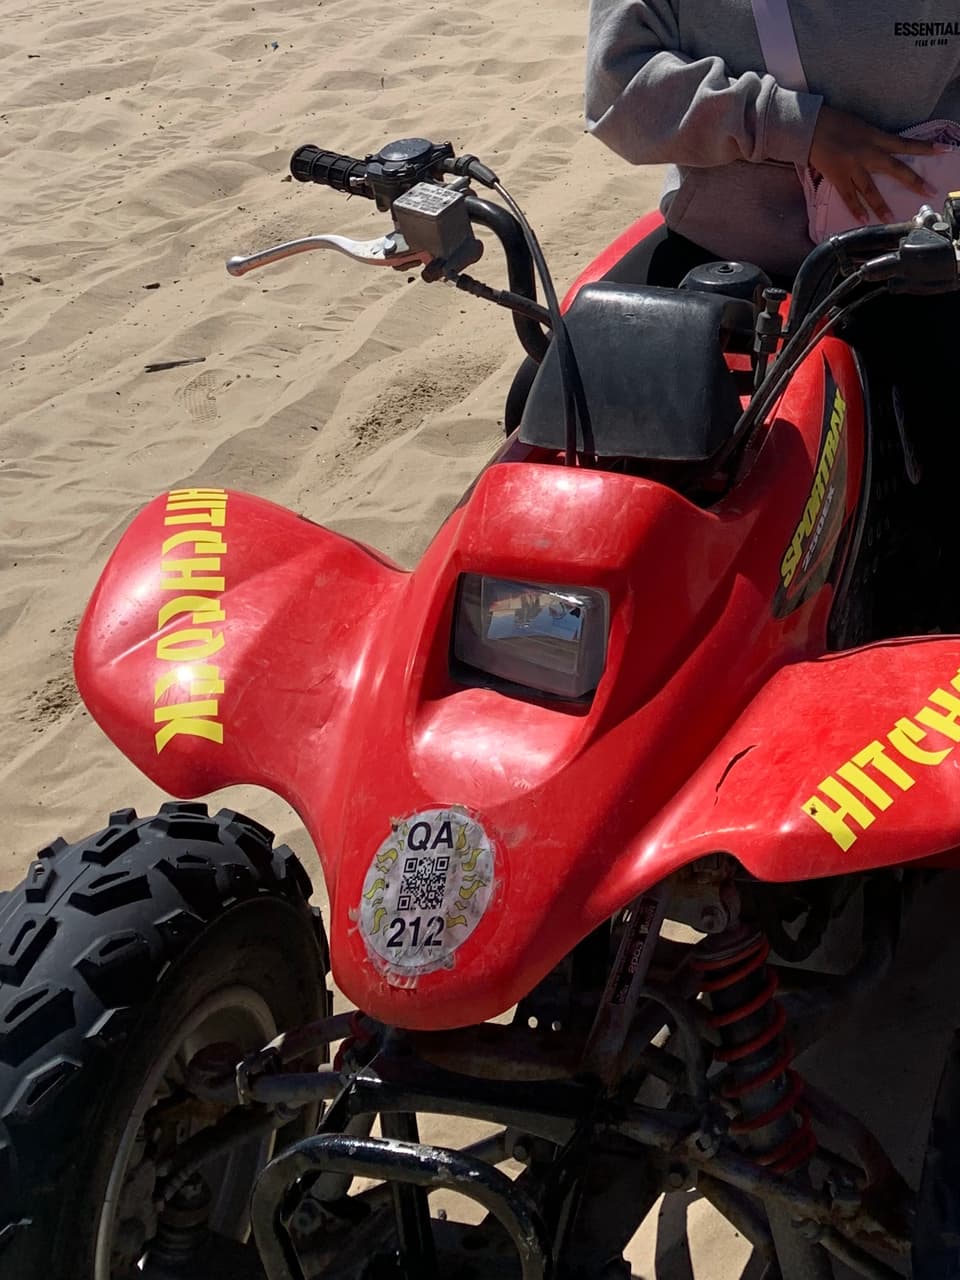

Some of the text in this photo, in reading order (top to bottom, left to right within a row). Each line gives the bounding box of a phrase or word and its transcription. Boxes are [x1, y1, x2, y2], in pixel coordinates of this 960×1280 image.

[781, 387, 847, 588] SPORTRAX
[154, 488, 228, 755] HITCHCOCK
[407, 821, 454, 852] QA
[386, 916, 445, 948] 212
